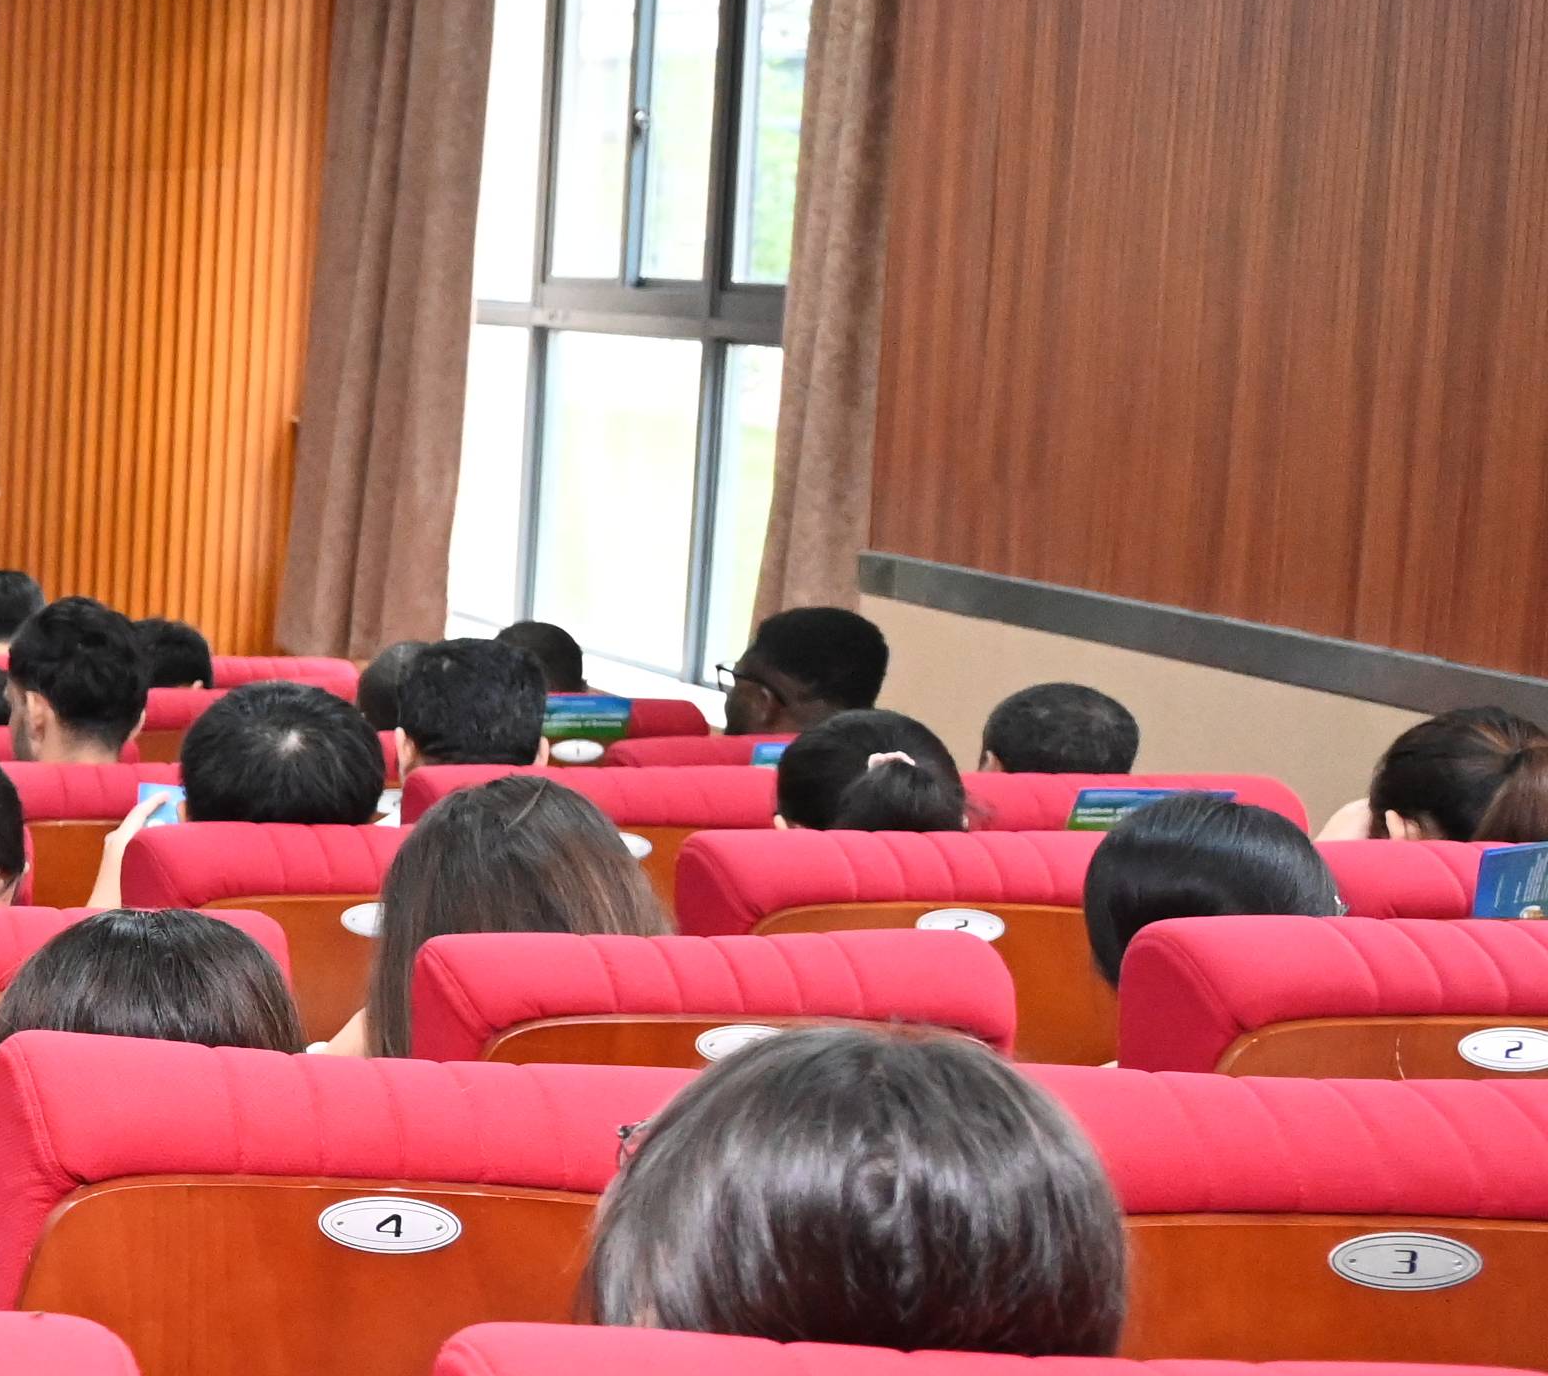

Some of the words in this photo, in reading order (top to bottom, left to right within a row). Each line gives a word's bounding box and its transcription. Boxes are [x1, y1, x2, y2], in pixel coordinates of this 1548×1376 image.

[1505, 1040, 1523, 1058] 2
[376, 1213, 403, 1237] 4
[1391, 1249, 1418, 1275] 3
